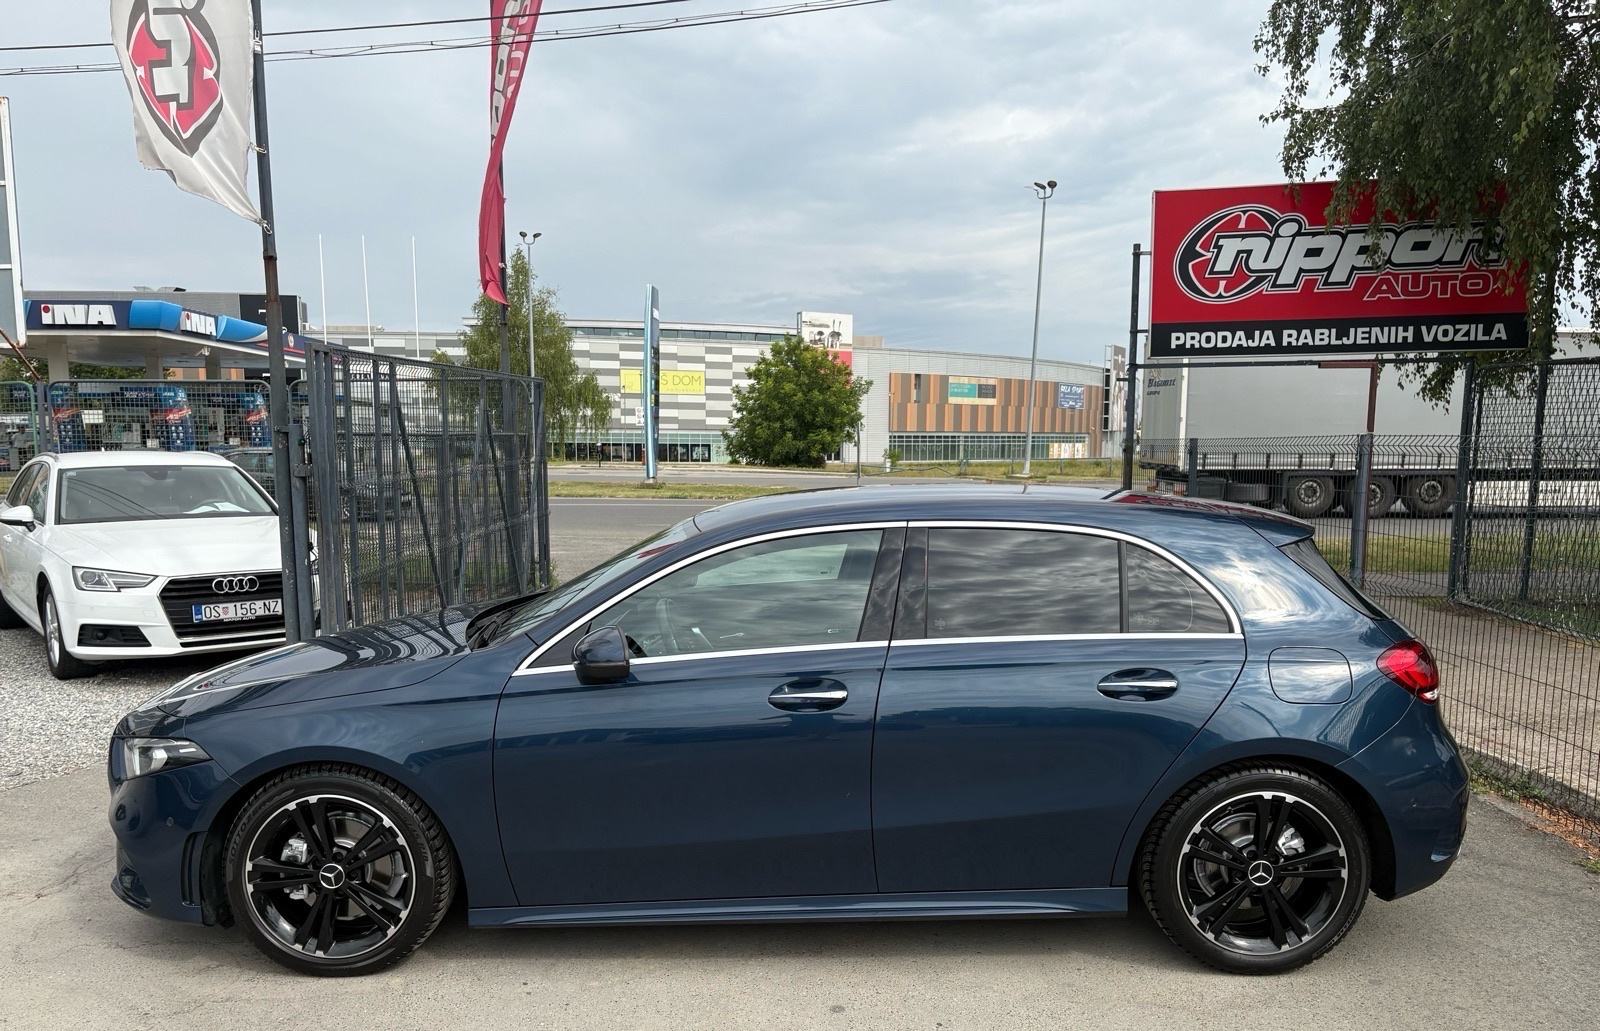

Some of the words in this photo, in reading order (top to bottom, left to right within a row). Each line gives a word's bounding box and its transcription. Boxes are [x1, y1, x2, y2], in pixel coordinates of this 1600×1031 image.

[1362, 272, 1494, 301] AUTO
[1170, 328, 1276, 350] PRODAJA
[1281, 325, 1414, 348] RABLJENIH
[1420, 322, 1508, 344] VOZILA
[672, 374, 702, 386] DOM
[203, 605, 221, 619] OS
[233, 600, 280, 617] 156-NZ
